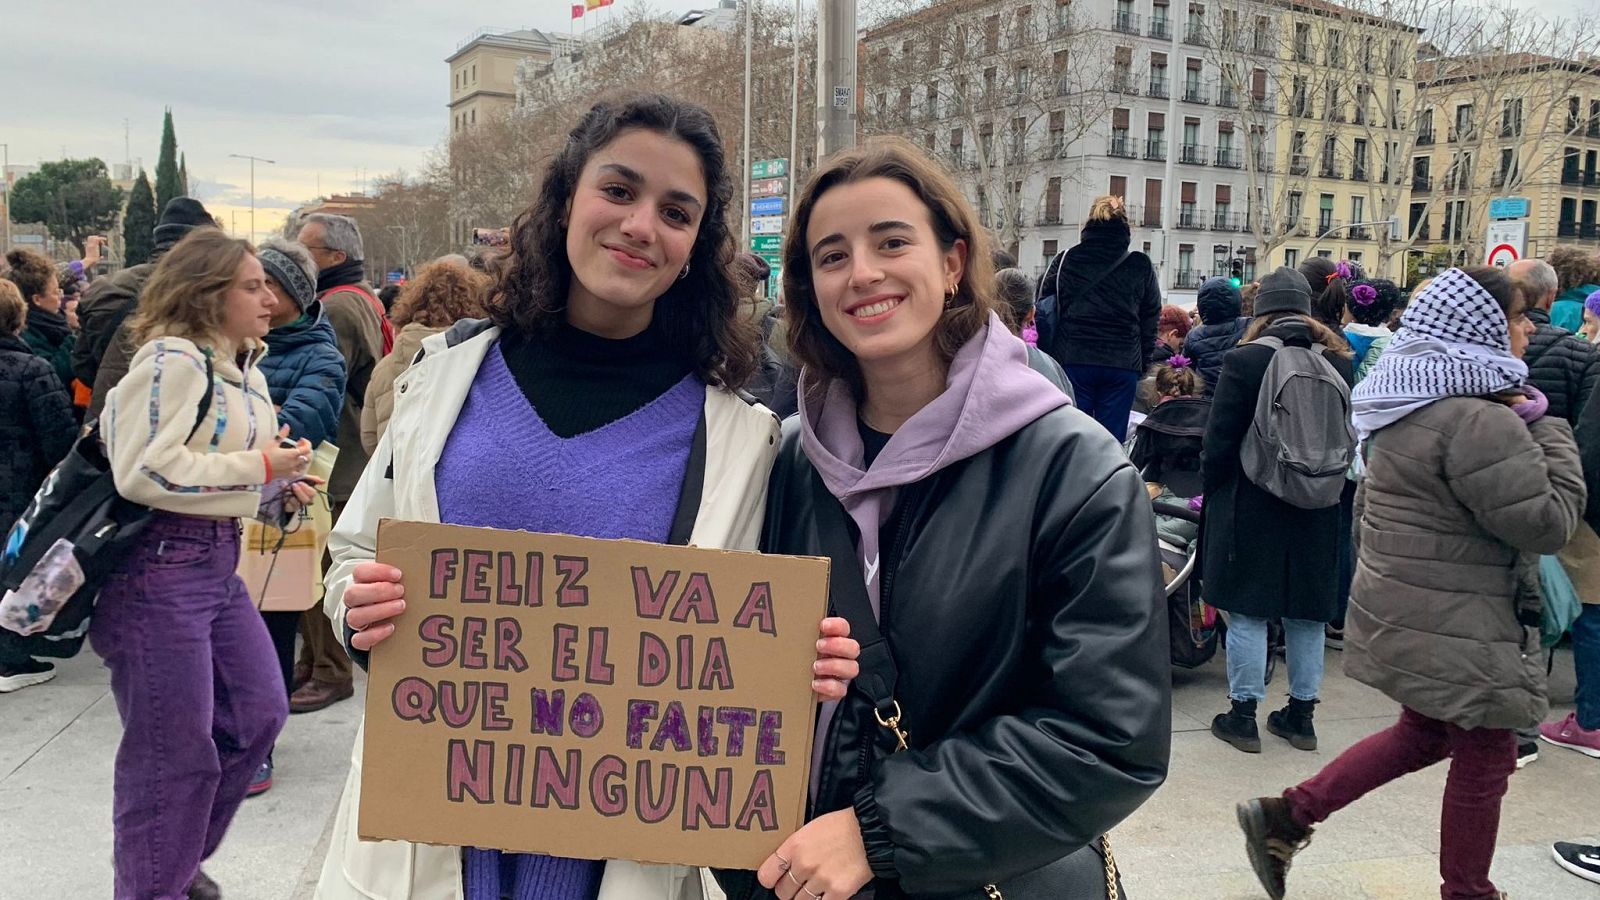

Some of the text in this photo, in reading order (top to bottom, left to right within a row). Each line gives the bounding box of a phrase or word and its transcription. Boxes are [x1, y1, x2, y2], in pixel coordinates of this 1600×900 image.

[429, 549, 777, 638] FELIZ VA A
[418, 614, 734, 690] SER EL DIA
[391, 676, 786, 765] QUE NO FALTE
[447, 738, 779, 831] NINGUNA
